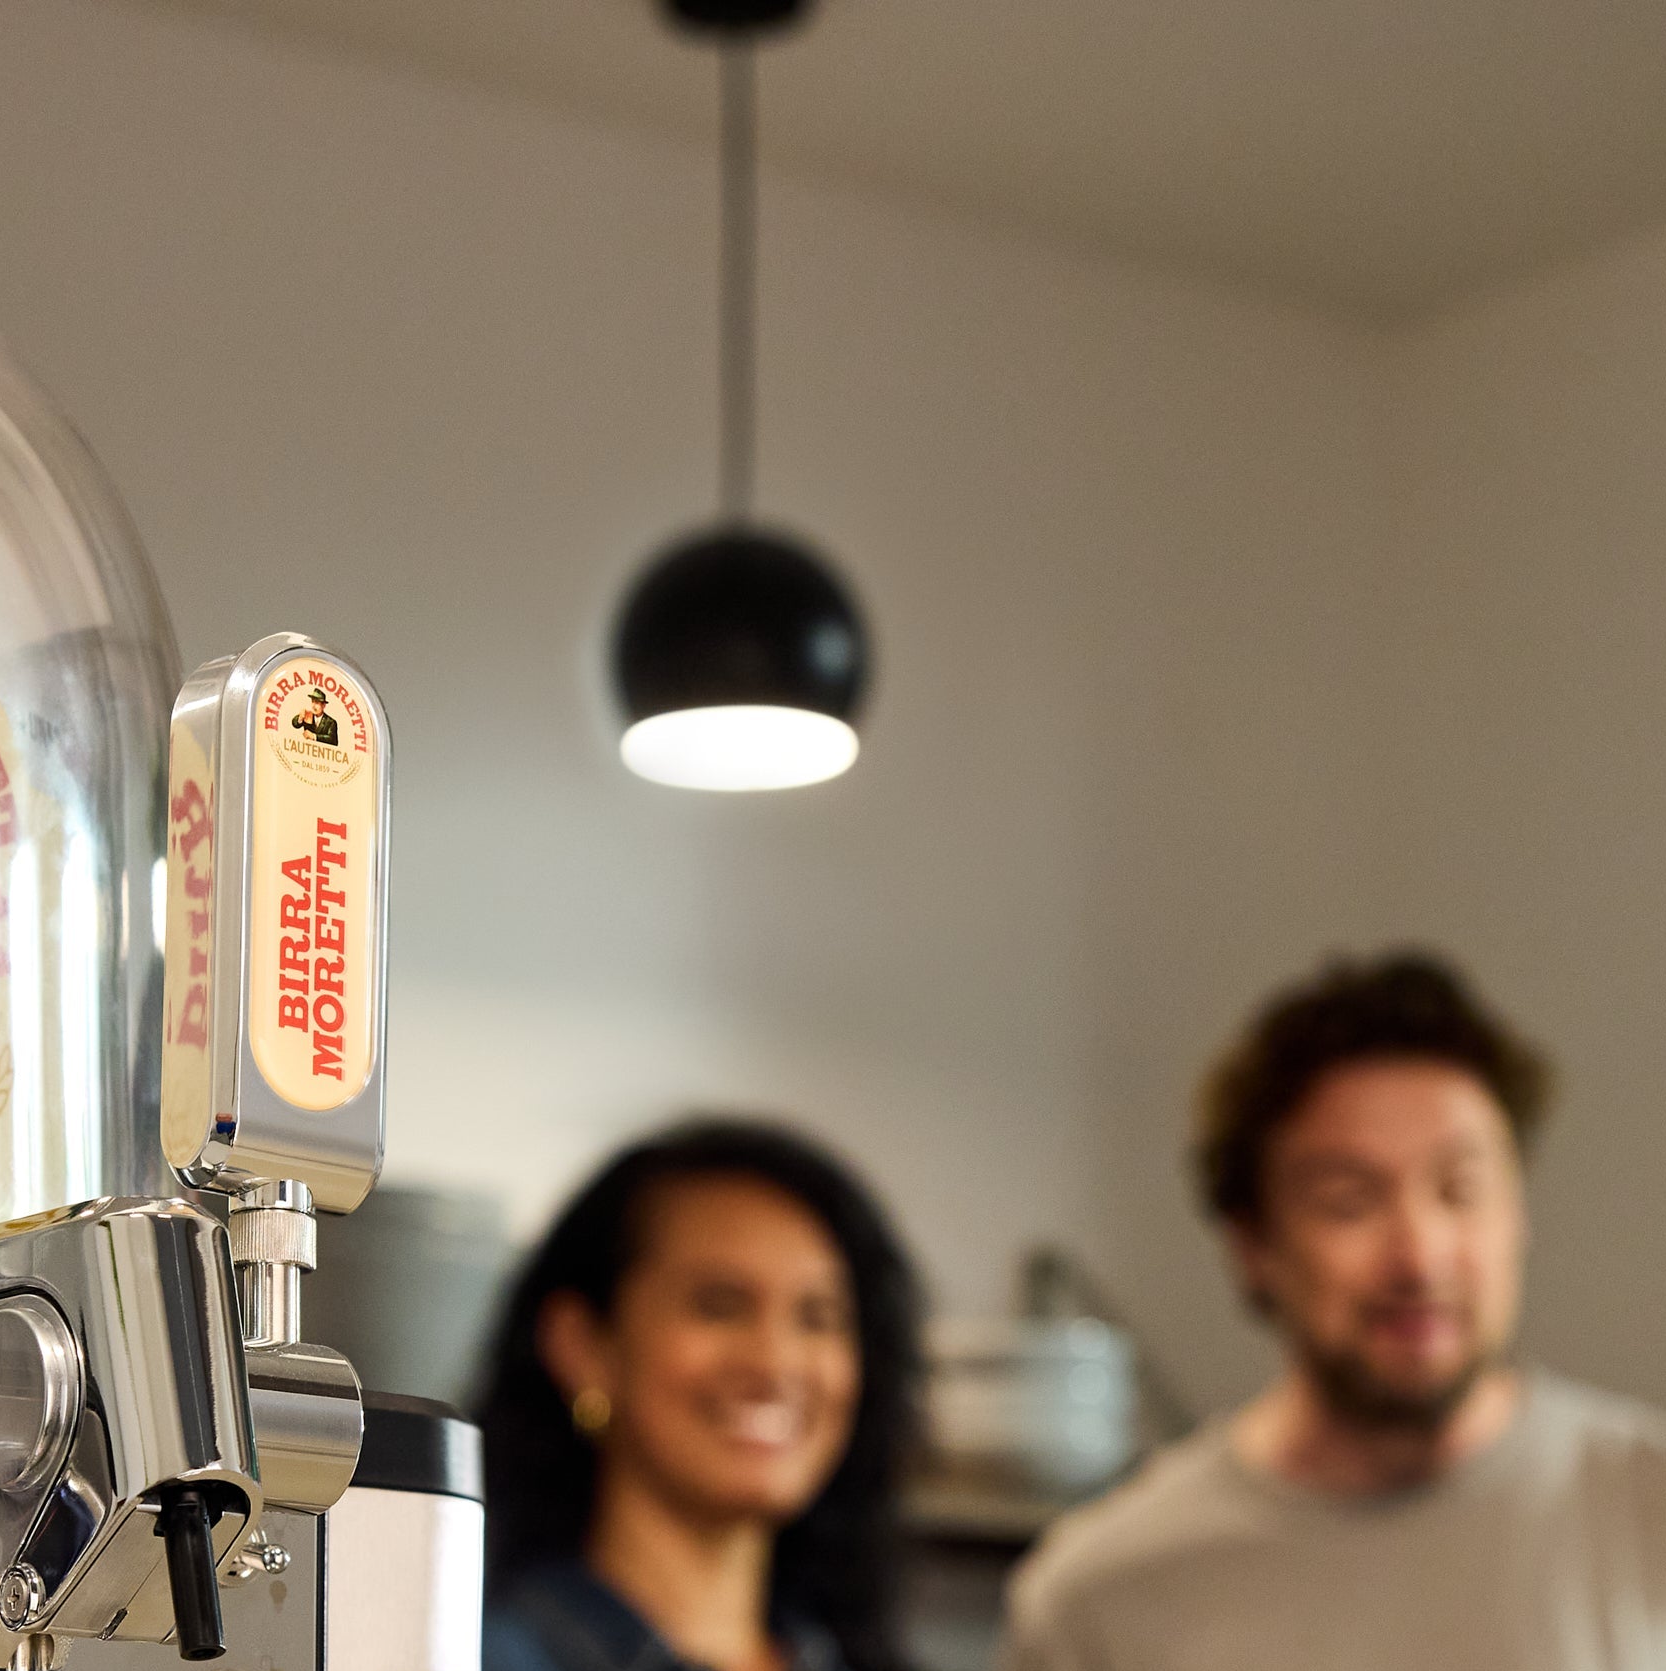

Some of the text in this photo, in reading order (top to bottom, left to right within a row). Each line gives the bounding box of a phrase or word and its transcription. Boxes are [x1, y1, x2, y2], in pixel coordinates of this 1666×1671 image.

[264, 669, 367, 753] BIRRA MORETTI
[283, 737, 350, 765] L'AUTENTICA
[278, 854, 313, 1034] BIRRA
[312, 816, 348, 1083] MORETTI
